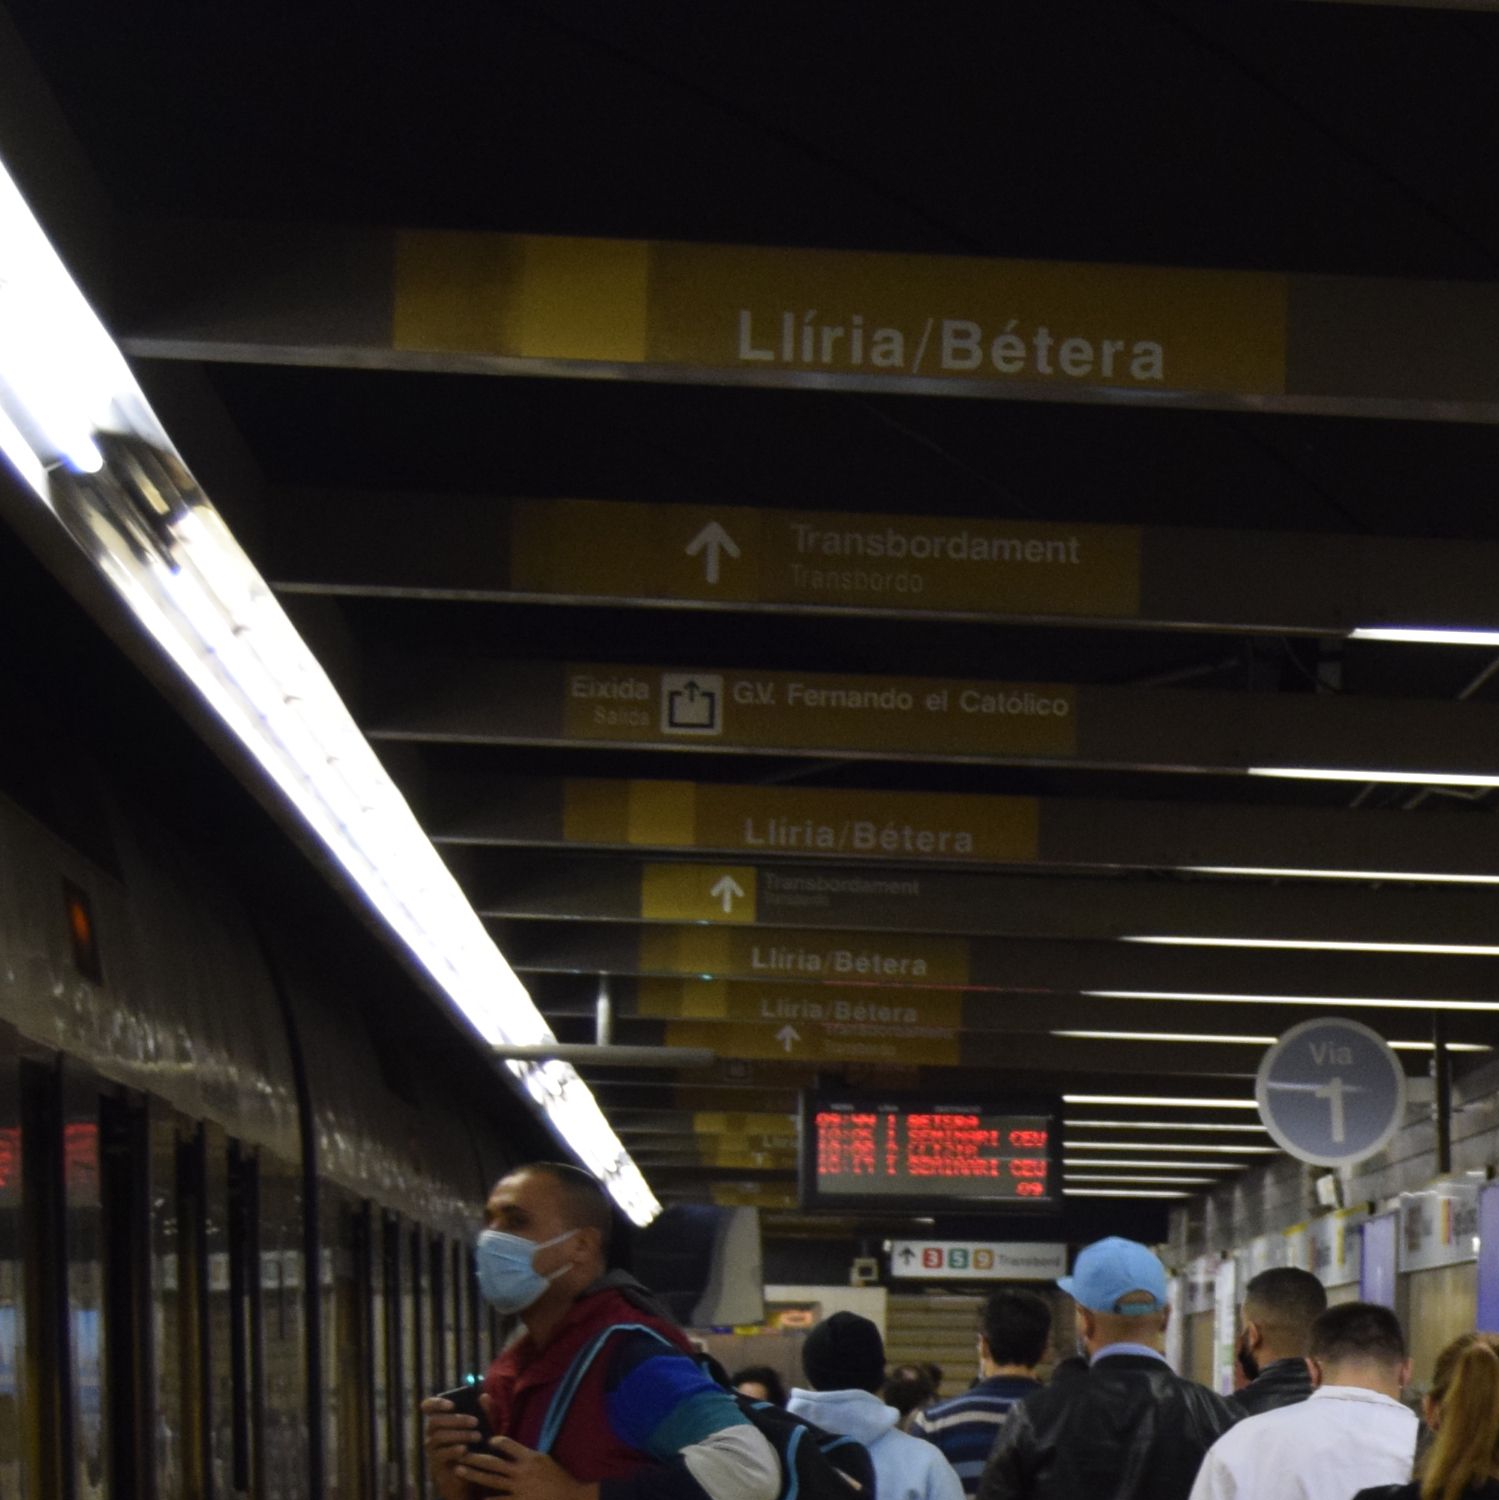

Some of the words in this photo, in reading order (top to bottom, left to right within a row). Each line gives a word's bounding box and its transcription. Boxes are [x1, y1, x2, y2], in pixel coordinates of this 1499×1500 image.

[738, 309, 1164, 381] Llíria/Bétera
[789, 523, 1081, 565] Transbordament
[571, 675, 649, 701] Eixida
[787, 683, 913, 710] Fernando
[926, 689, 949, 711] el
[960, 689, 1069, 716] Católico
[1315, 1077, 1345, 1144] 1
